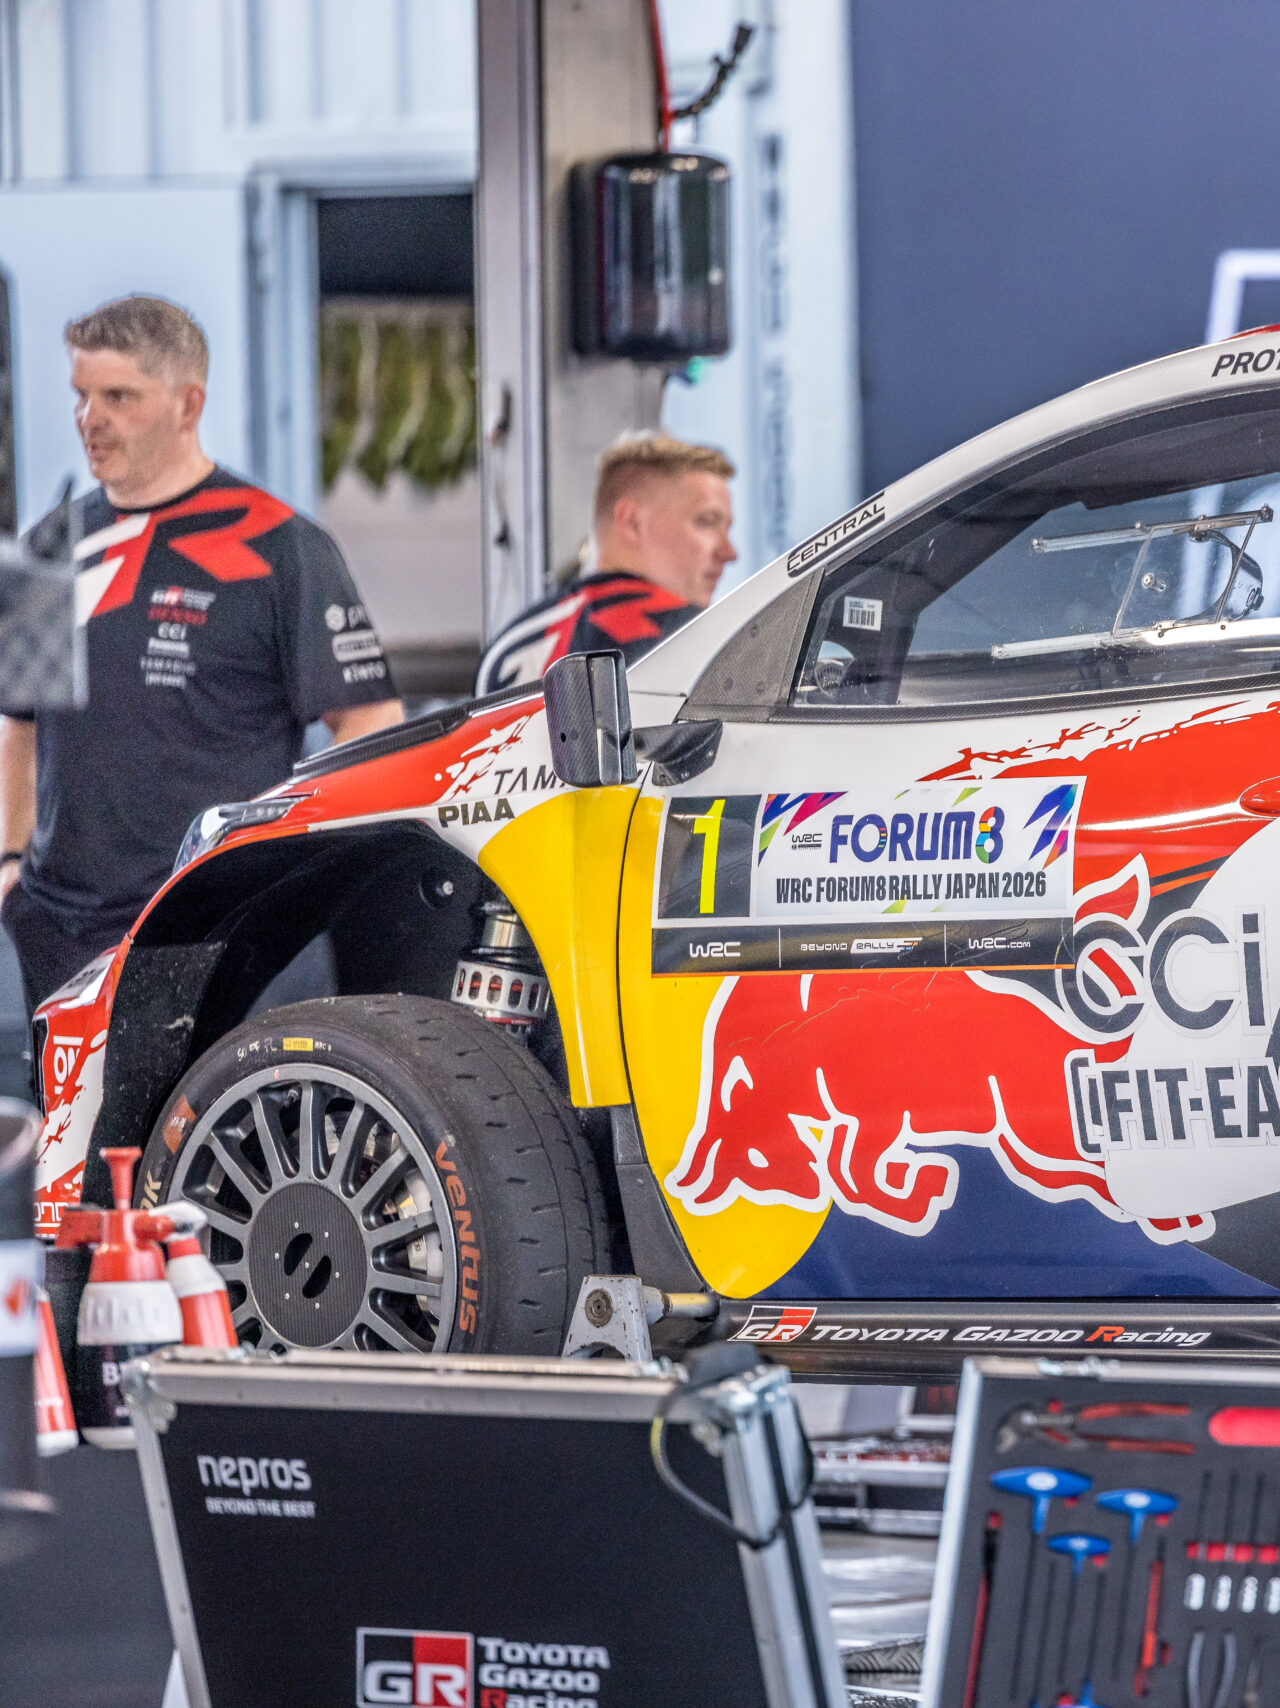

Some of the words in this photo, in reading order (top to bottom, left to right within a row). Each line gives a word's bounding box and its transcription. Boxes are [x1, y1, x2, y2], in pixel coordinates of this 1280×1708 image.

[787, 503, 885, 572] CENTRAL
[438, 798, 516, 829] PIAA
[791, 833, 822, 843] WRC
[829, 805, 1005, 865] FORUM8
[693, 798, 726, 914] 1
[776, 878, 813, 904] WRC
[816, 874, 886, 903] FORUM8
[888, 873, 943, 901] RALLY
[945, 872, 1000, 900] JAPAN
[1001, 870, 1047, 898] 2026
[689, 941, 741, 958] WRC
[855, 941, 895, 951] RALLY
[736, 1323, 804, 1341] GR
[810, 1325, 950, 1341] TOYOTA
[953, 1325, 1085, 1342] GAZOO
[1084, 1325, 1212, 1346] Racing
[197, 1455, 312, 1496] nepros
[477, 1637, 611, 1670] TOYOTA
[364, 1660, 467, 1706] GR
[477, 1662, 601, 1693] GAZOO
